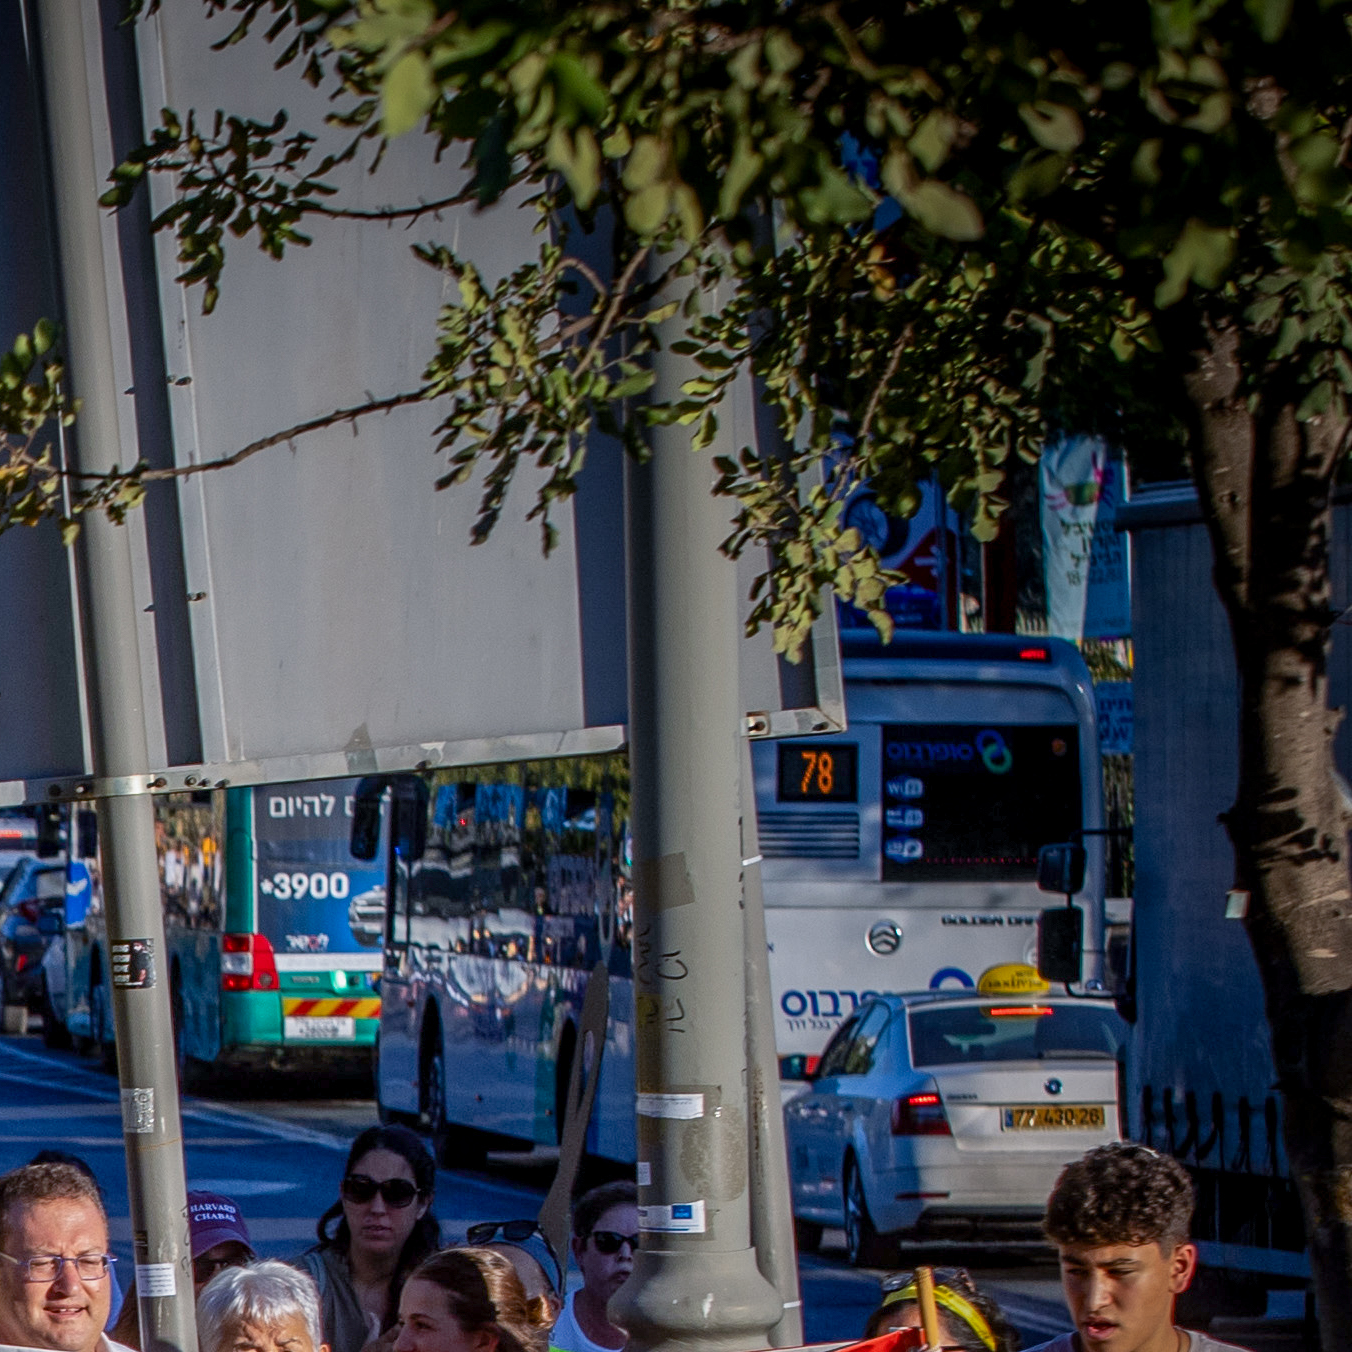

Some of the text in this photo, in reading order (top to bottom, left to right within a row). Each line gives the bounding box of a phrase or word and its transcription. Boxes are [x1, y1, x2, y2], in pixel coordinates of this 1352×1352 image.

[800, 752, 834, 794] 78
[269, 793, 336, 818] להיום
[190, 1203, 236, 1214] HARVARD
